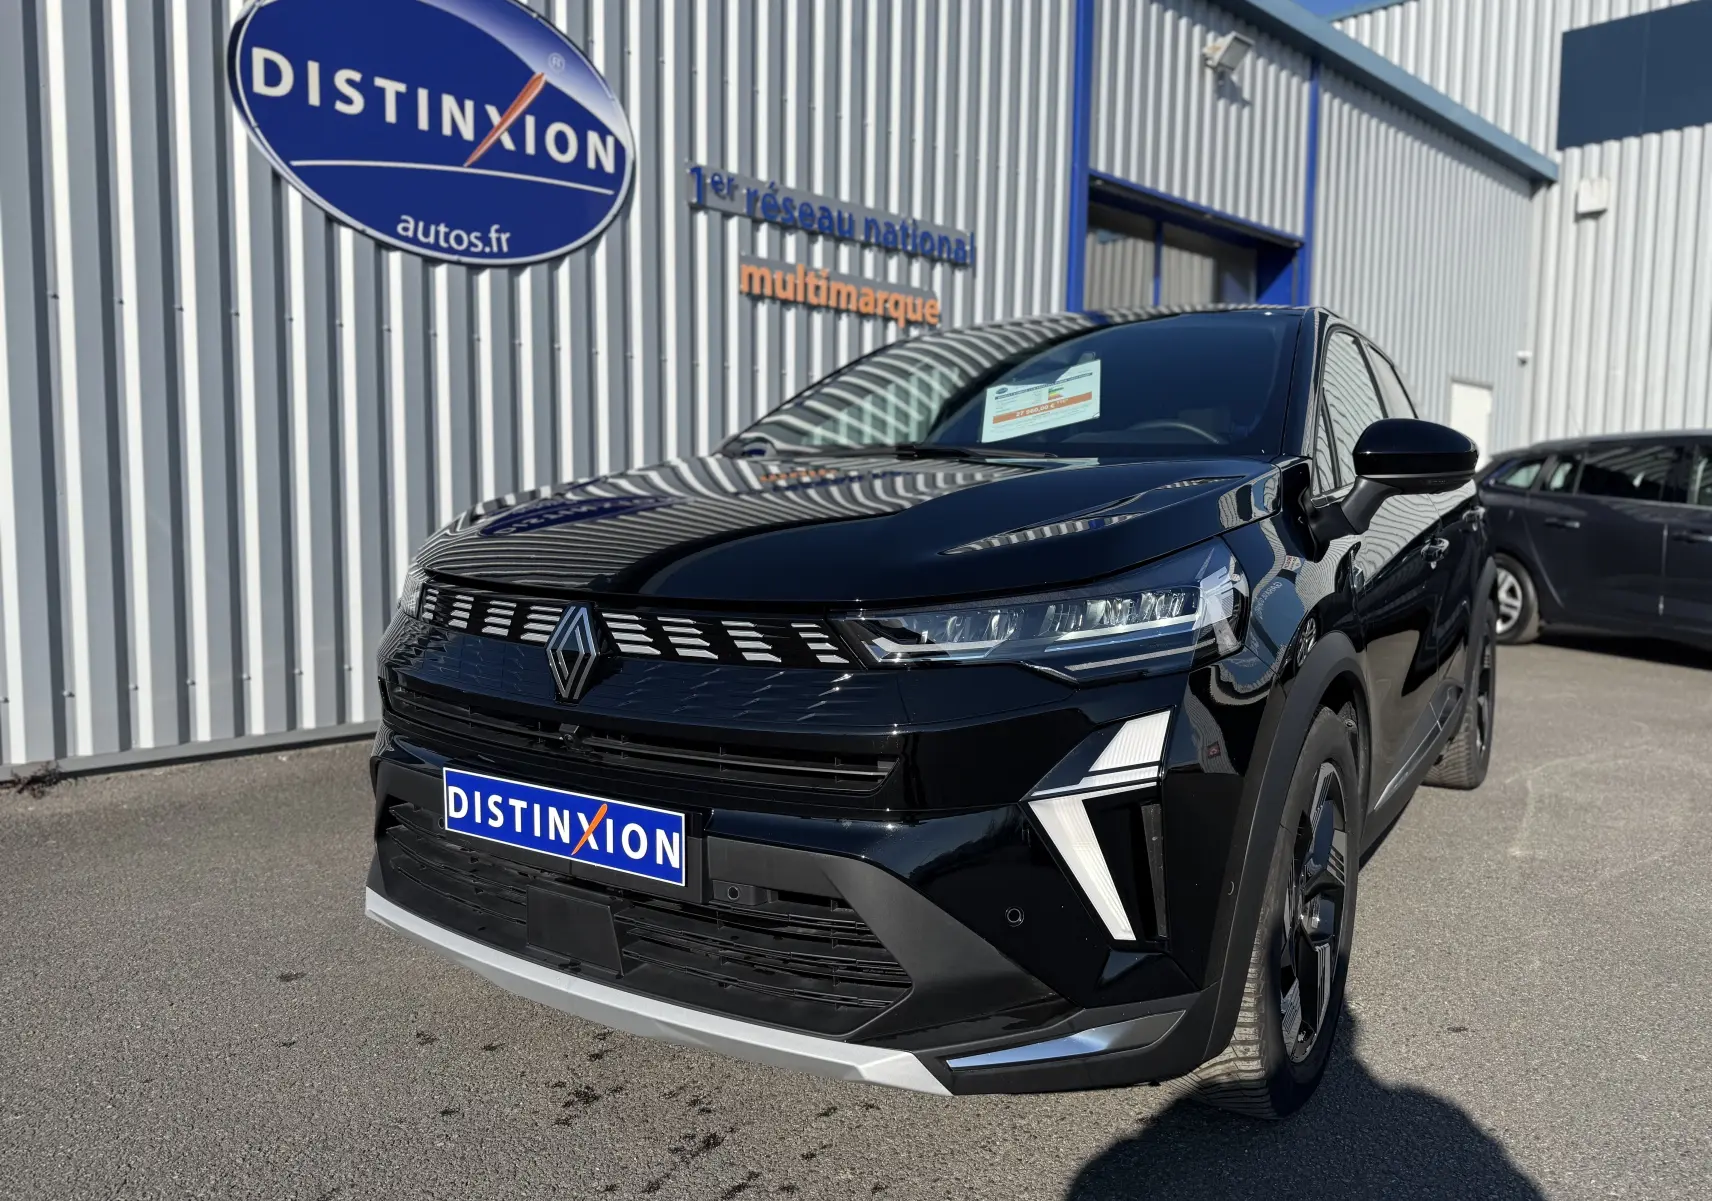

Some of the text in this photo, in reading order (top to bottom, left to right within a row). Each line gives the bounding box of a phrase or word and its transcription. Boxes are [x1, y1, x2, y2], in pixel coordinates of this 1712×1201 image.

[251, 46, 615, 174] DISTINXION
[396, 214, 510, 253] autos.fr
[745, 180, 856, 240] réseau
[863, 218, 975, 266] national
[740, 263, 940, 329] multimarque
[447, 785, 680, 869] DISTINXION
